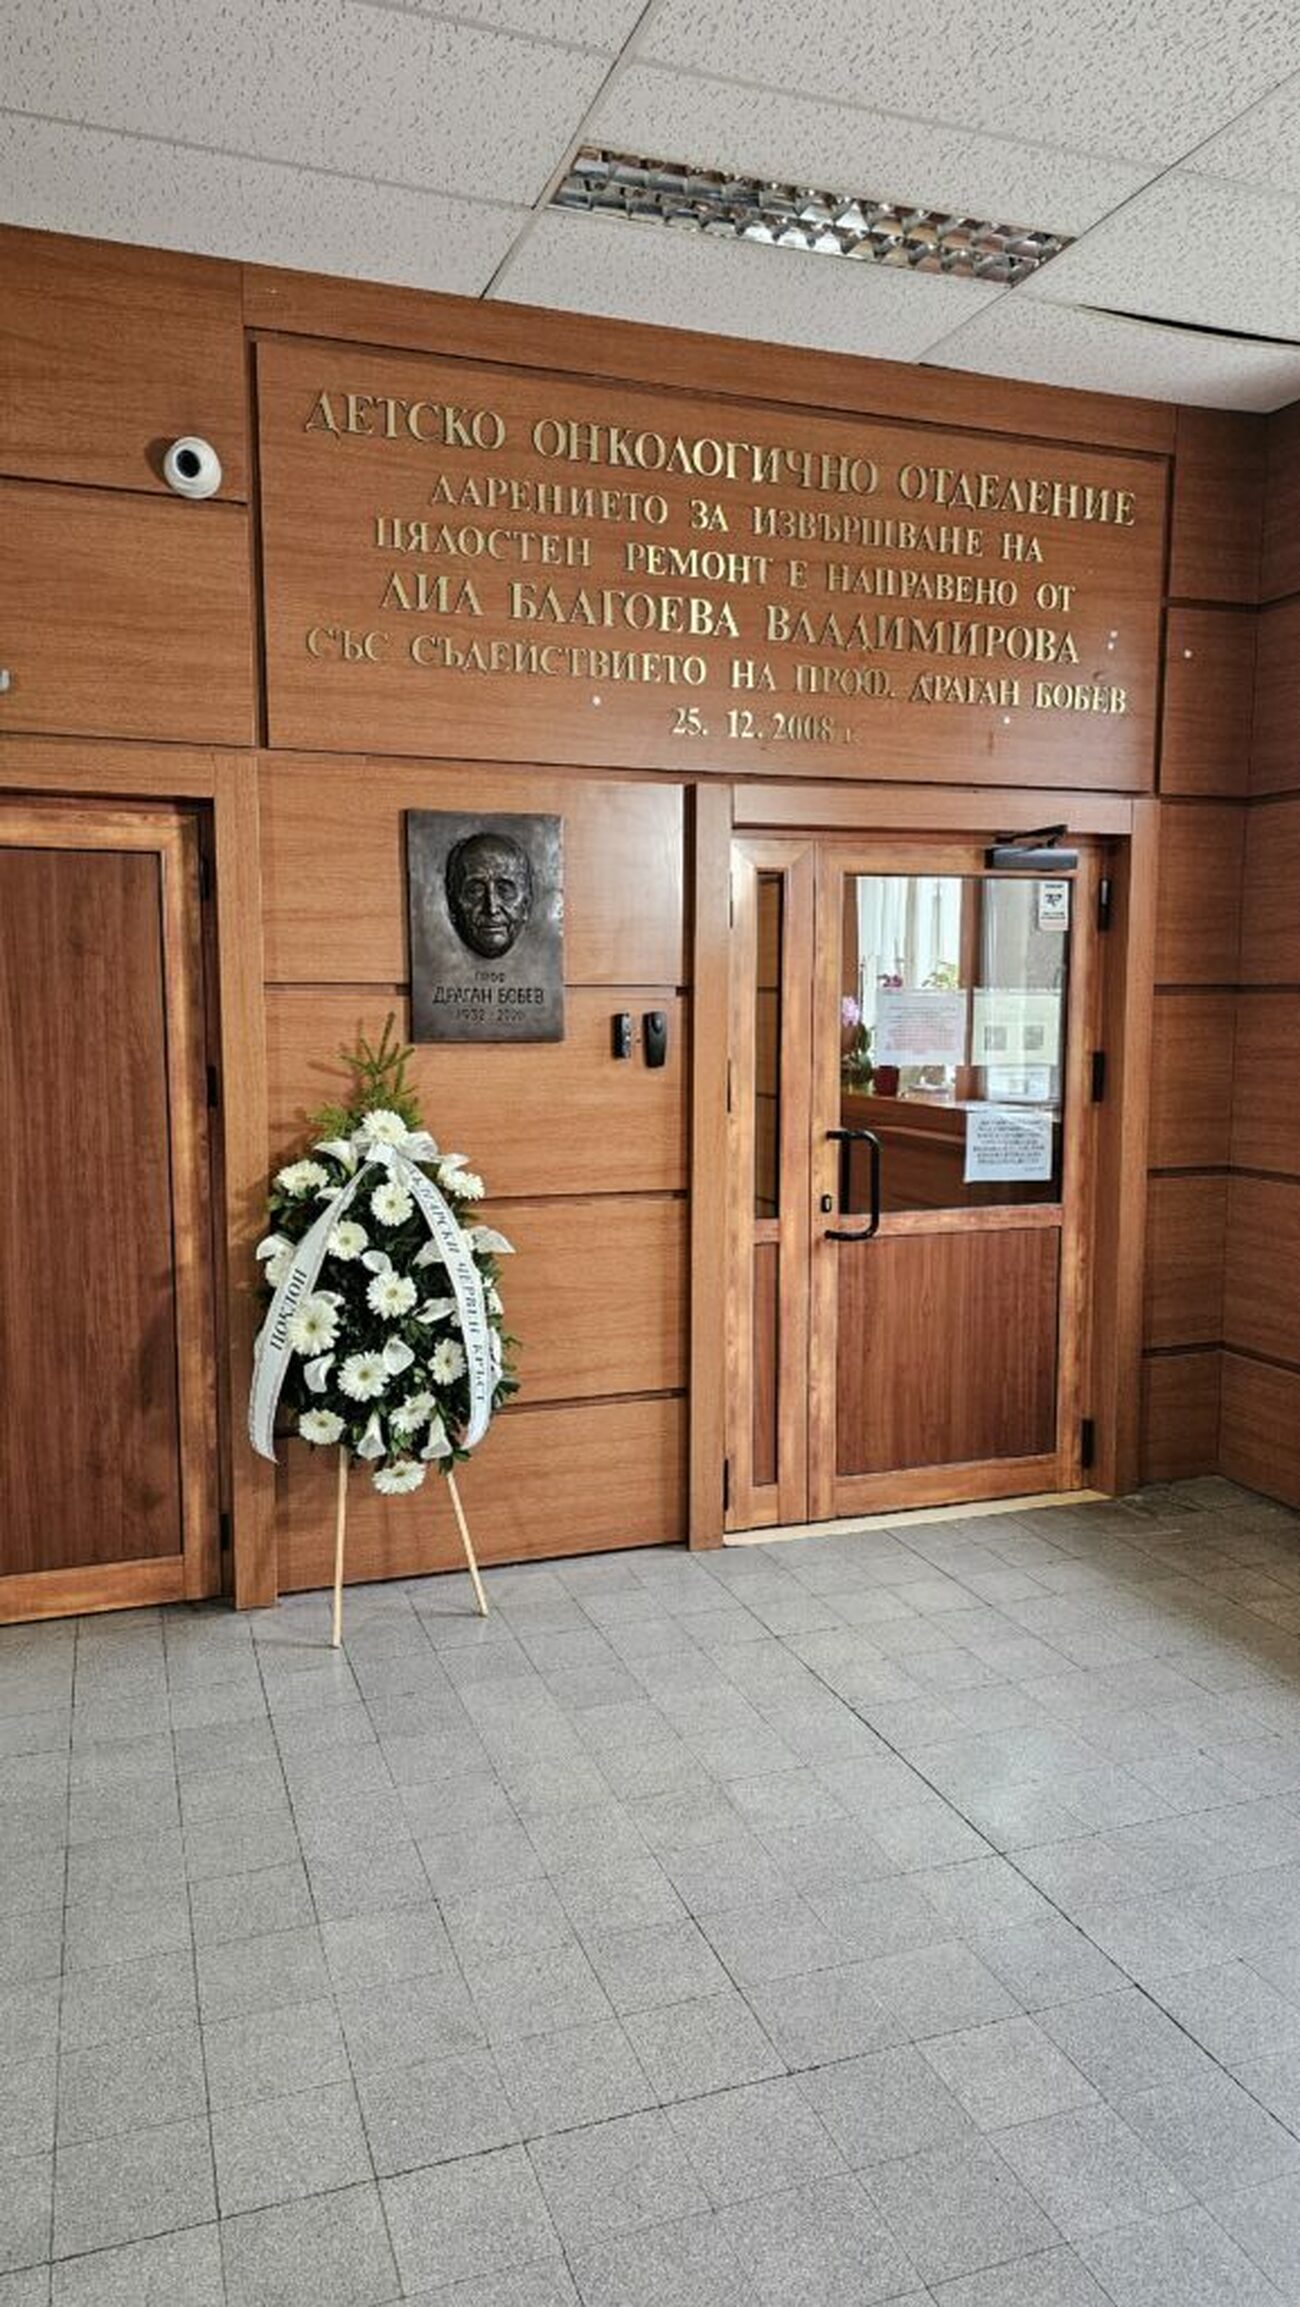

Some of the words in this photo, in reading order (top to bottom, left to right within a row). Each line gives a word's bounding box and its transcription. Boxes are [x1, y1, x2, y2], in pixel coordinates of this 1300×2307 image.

[304, 391, 507, 450] ДЕТСКО
[533, 418, 879, 496] ОНКОЛОГИЧНО
[899, 463, 1137, 528] ОТДЕЛЕНИЕ
[431, 475, 669, 525] ДАРЕНИЕТО
[691, 500, 729, 532] ЗА
[752, 505, 985, 558] ИЗВЪРШВАНЕ
[1002, 533, 1045, 563] НА
[374, 516, 592, 567] ЦЯЛОСТЕН
[625, 541, 774, 585] РЕМОНТ
[788, 560, 808, 589] Е
[828, 562, 1018, 609] НАПРАВЕНО
[1037, 582, 1076, 612] ОТ
[381, 571, 484, 617] ЛИА
[508, 581, 740, 638] БЛАГОЕВА
[767, 604, 1080, 665] ВЛАДИМИРОВА
[306, 626, 389, 662] СЪС
[410, 633, 708, 686] СЪДЕЙСТВИЕТО
[731, 659, 777, 693] НА
[910, 673, 1020, 708] ДРАГАН
[1033, 681, 1128, 715] БОБЕВ
[672, 706, 709, 737] 25.
[432, 986, 493, 1005] ДРАГАН
[497, 987, 545, 1006] БОБЕВ
